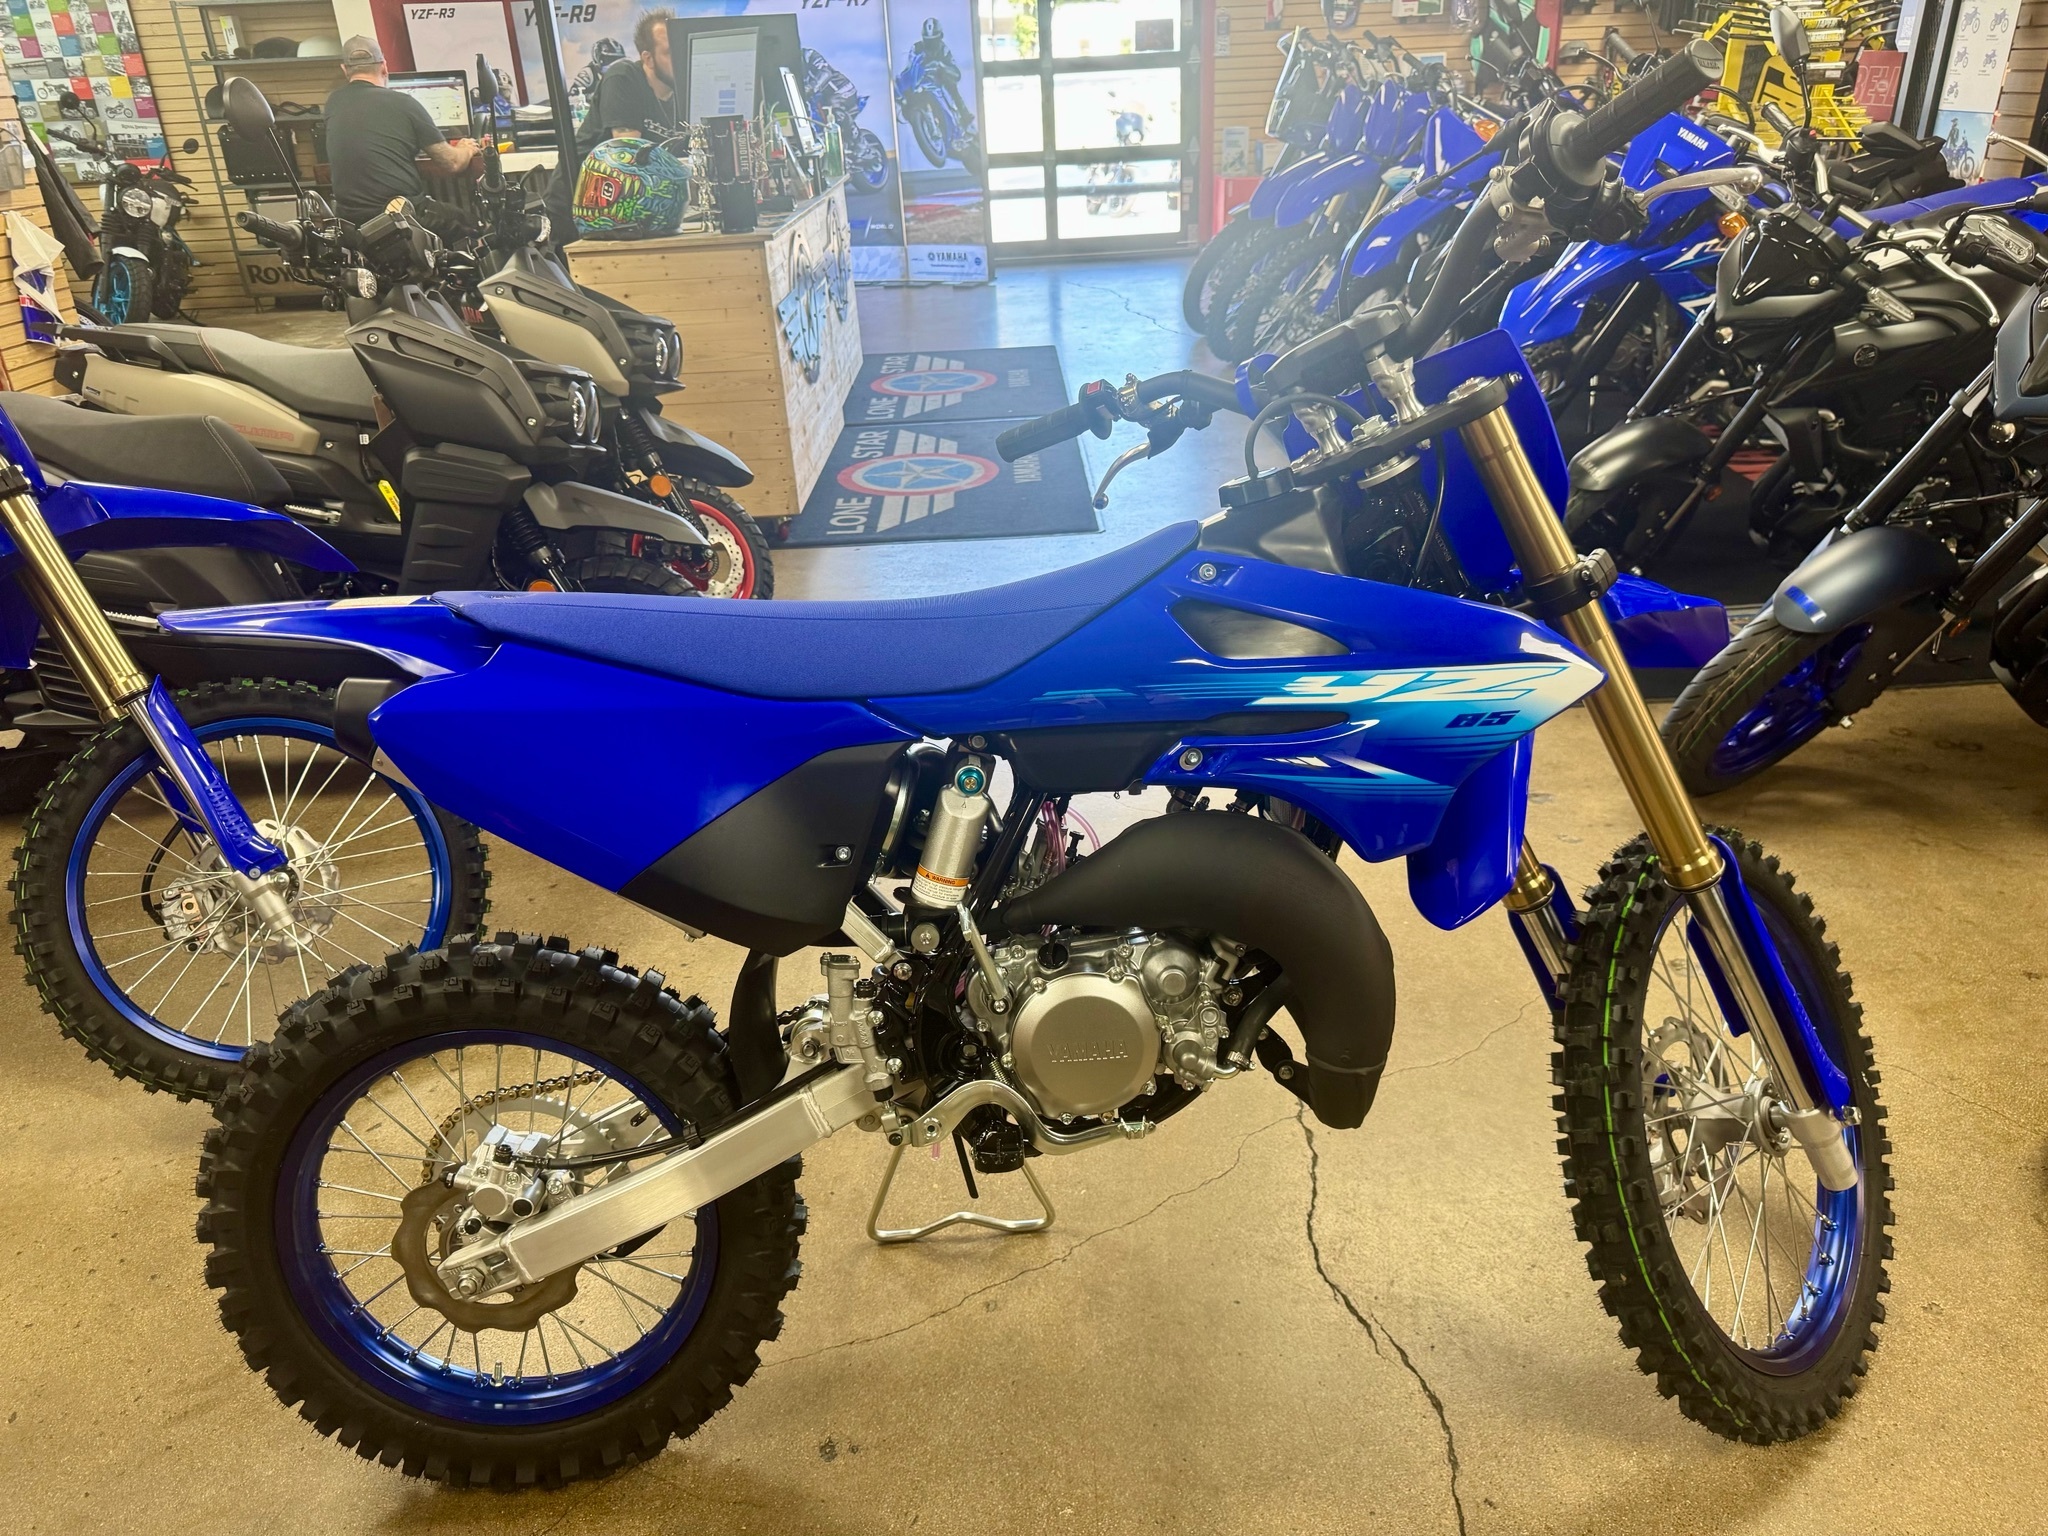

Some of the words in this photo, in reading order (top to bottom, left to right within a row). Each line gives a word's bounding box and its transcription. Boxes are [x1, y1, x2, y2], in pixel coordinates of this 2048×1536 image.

[411, 8, 455, 19] YZF-R3
[524, 4, 596, 26] Y-R9
[1677, 126, 1709, 151] YAMAHA
[936, 252, 969, 262] YAMAHA
[880, 355, 910, 374] STAR
[864, 396, 899, 420] LONE
[826, 498, 872, 535] LONE
[851, 430, 889, 459] STAR
[1248, 664, 1570, 706] YZ
[1445, 710, 1521, 729] 85
[204, 779, 254, 848] YAMAHA
[931, 876, 956, 885] WARNING
[1046, 1040, 1128, 1063] YAMAHA
